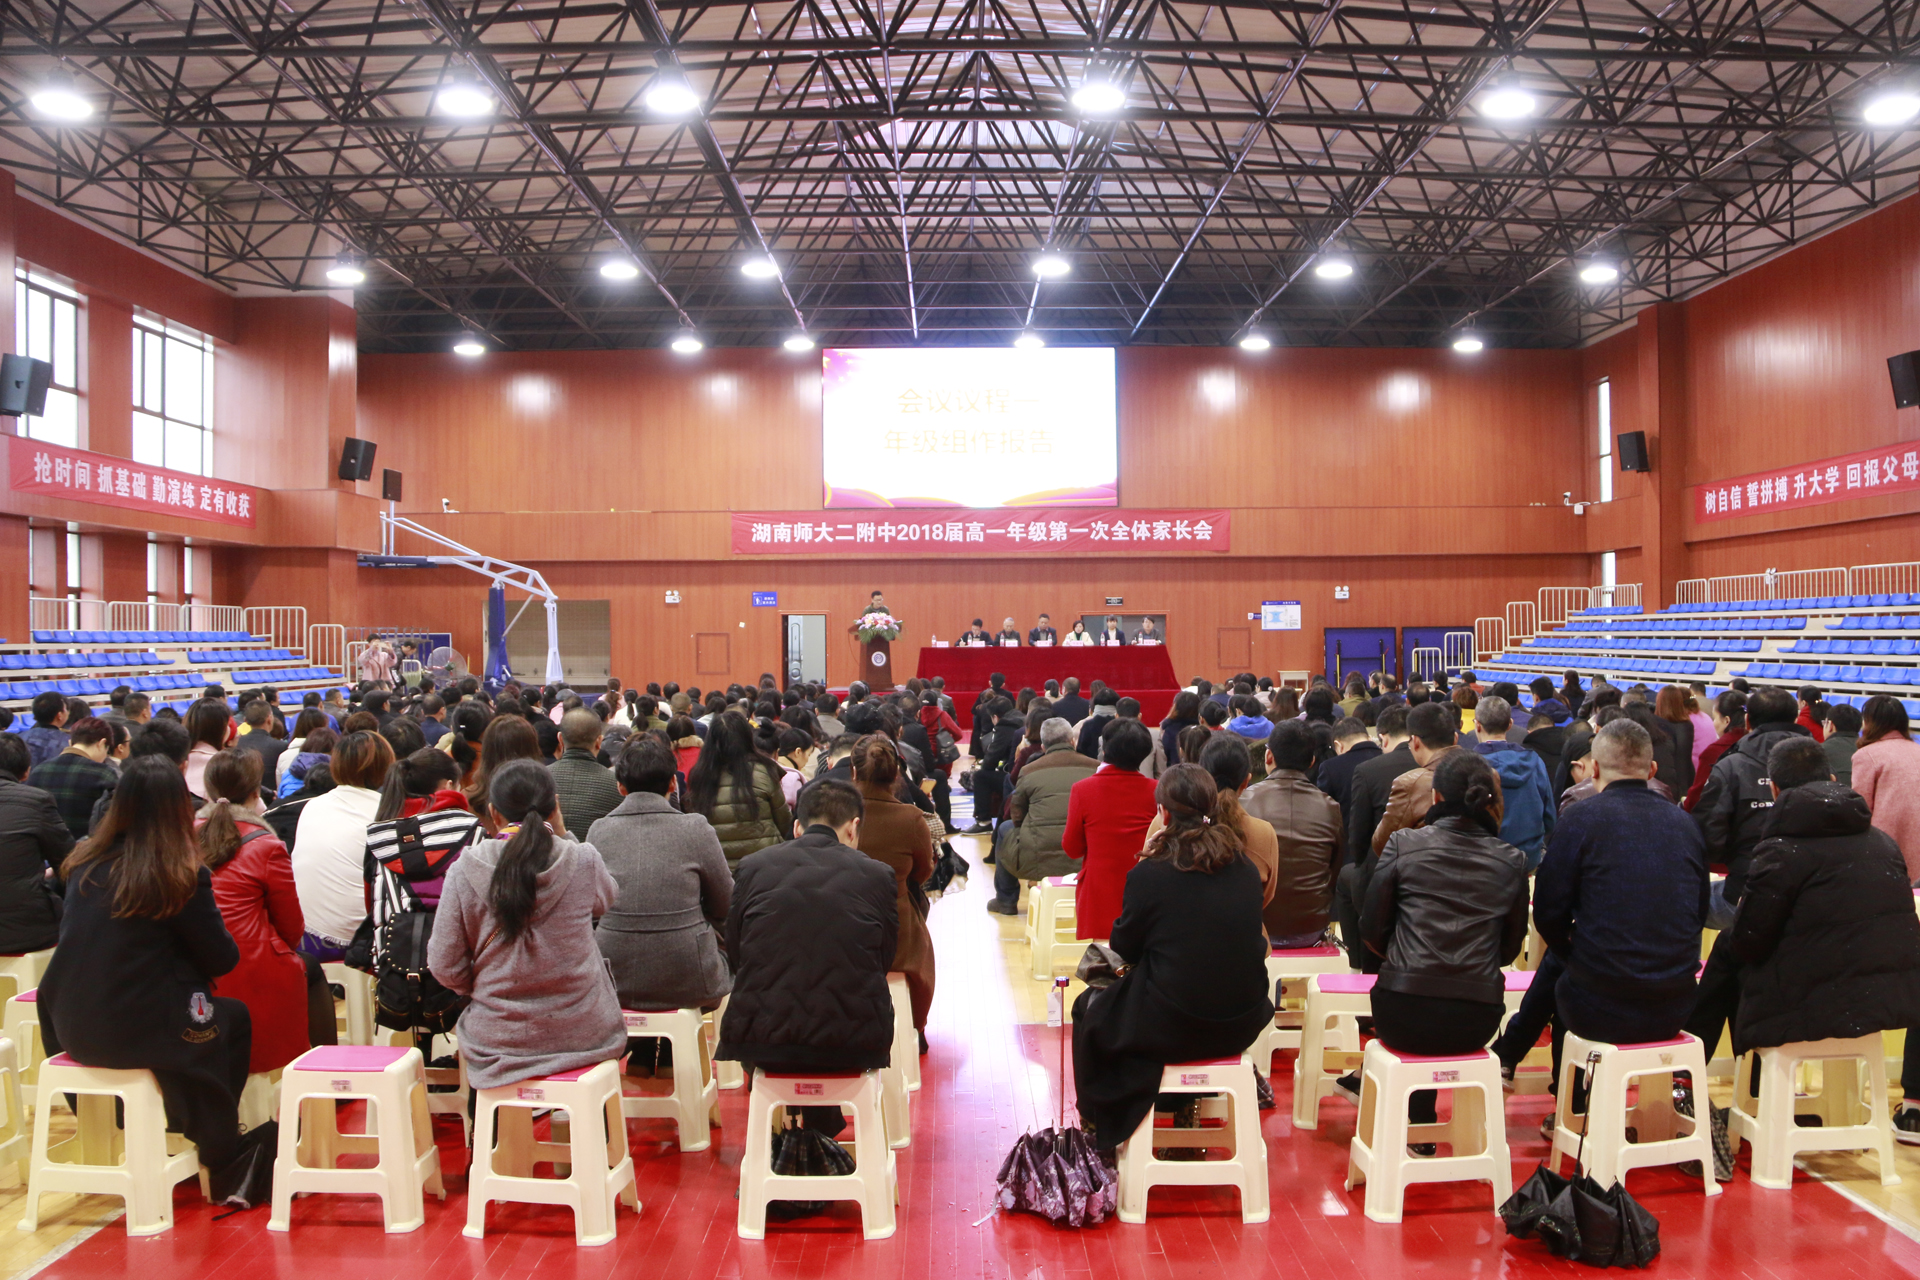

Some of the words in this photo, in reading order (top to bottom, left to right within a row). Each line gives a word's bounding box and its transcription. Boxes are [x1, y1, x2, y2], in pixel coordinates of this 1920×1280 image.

[897, 388, 1040, 414] 会议议程一
[883, 429, 1055, 455] 年级组作报告
[34, 451, 91, 490] 抢时间
[97, 463, 147, 500] 抓基础
[152, 475, 196, 508] 勤演练
[200, 485, 250, 518] 定有收获
[1705, 484, 1742, 514] 树自信
[1747, 476, 1788, 507] 誓拼搏
[1793, 466, 1840, 499] 升大学
[1846, 451, 1919, 490] 回报父母
[751, 520, 1213, 543] 湖南师大二附中2018届高一年级第一次全体家长会
